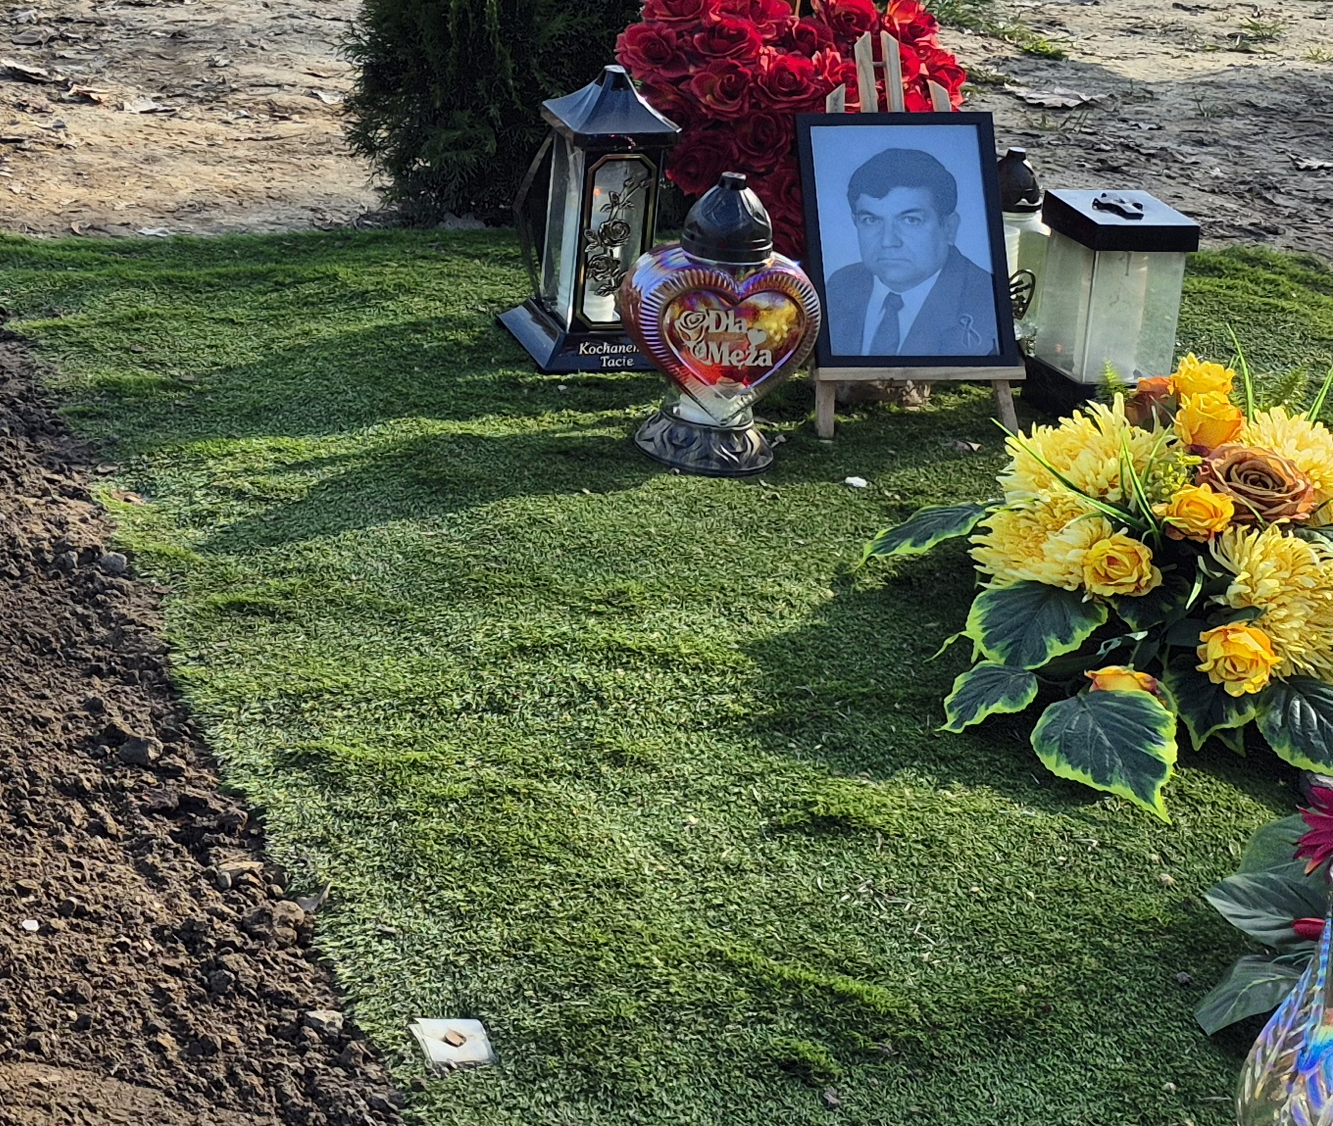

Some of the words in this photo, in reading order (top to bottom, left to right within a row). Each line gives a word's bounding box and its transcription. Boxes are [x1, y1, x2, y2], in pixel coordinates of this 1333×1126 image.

[708, 309, 748, 333] Dla
[600, 355, 634, 368] Tacie
[707, 342, 773, 370] Męża
